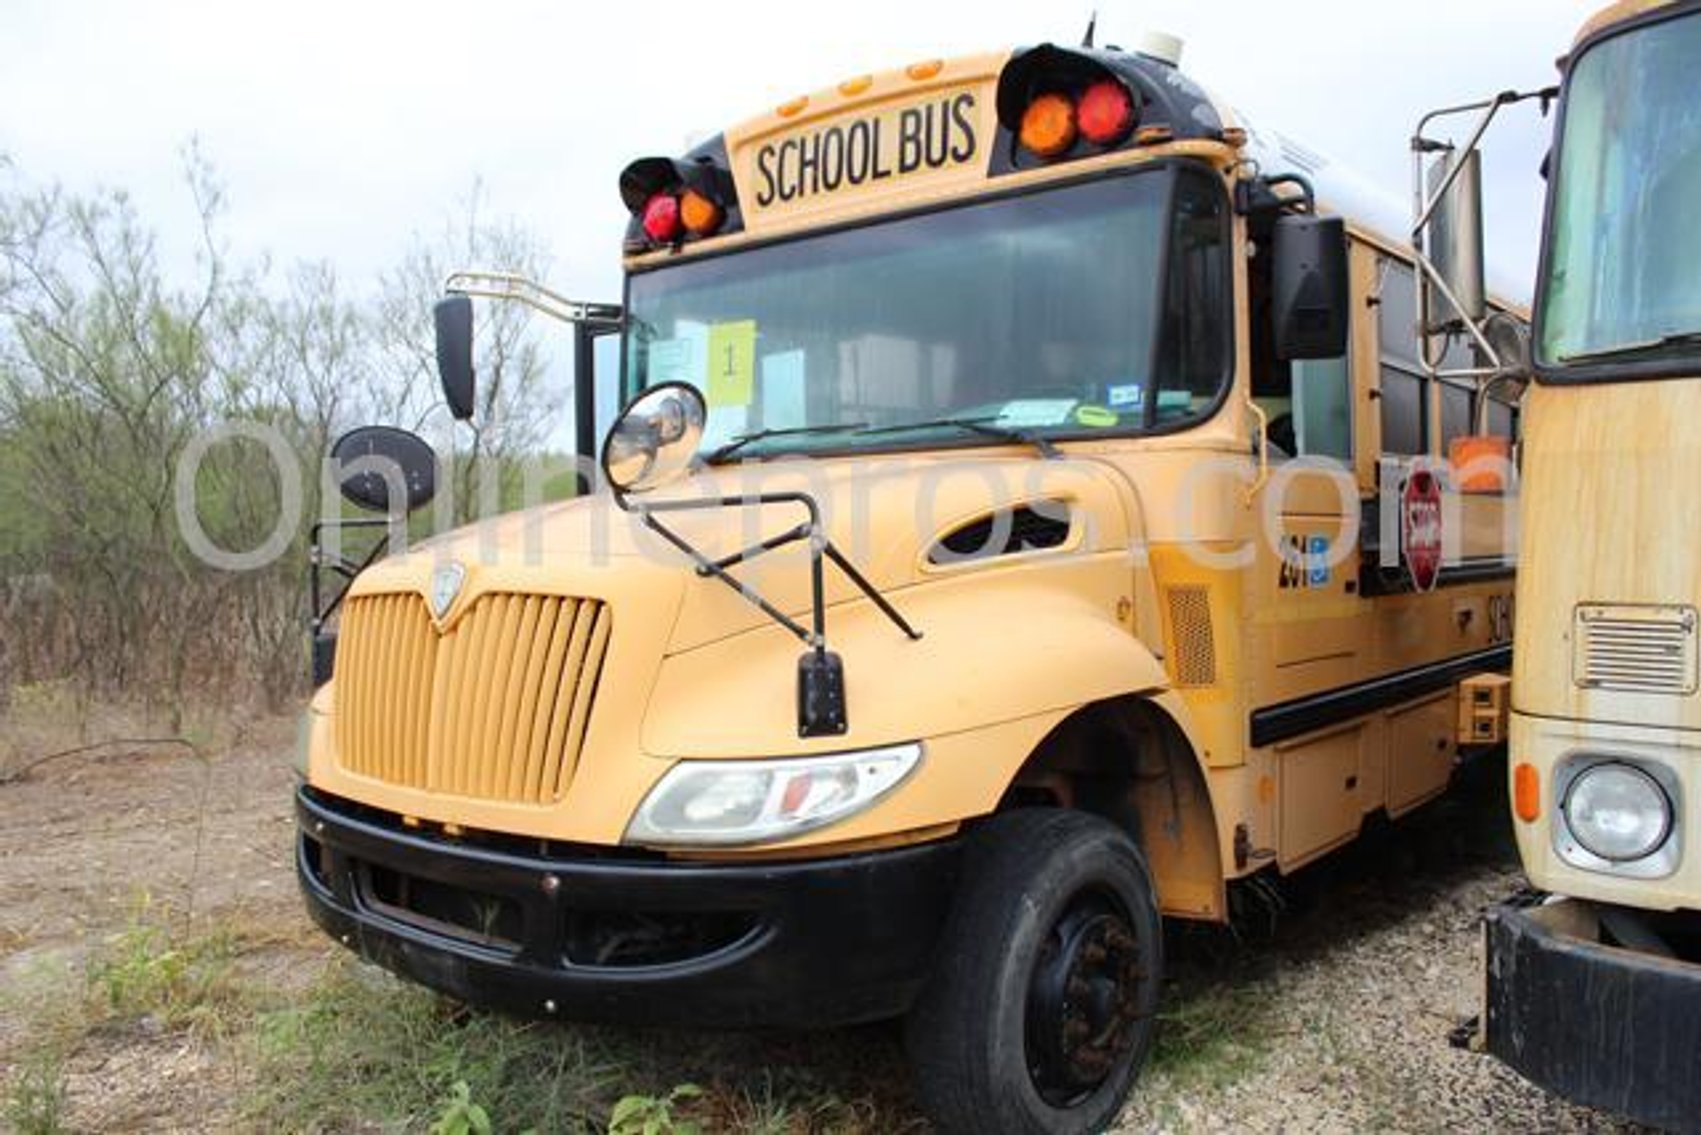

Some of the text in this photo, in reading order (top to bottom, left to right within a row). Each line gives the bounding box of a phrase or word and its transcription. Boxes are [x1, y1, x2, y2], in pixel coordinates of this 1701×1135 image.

[757, 93, 977, 206] SCHOOL BUS
[723, 341, 735, 376] 1
